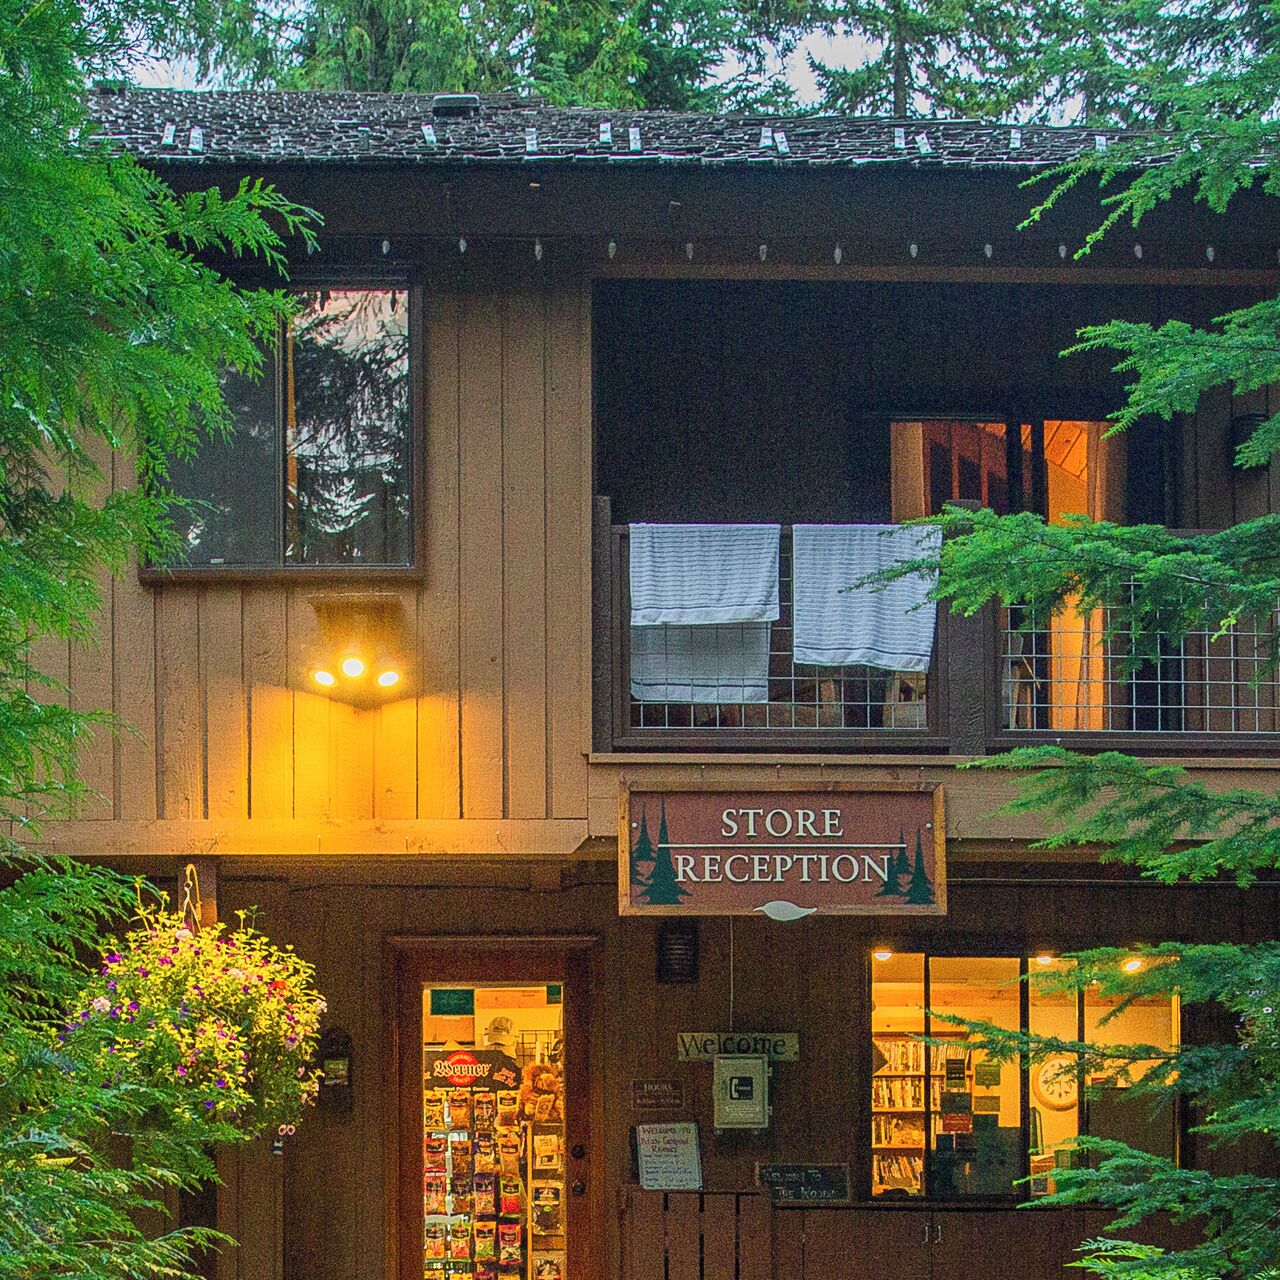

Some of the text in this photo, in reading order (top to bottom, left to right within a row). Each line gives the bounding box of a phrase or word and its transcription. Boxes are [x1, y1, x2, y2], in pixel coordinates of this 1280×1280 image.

[721, 808, 844, 837] STORE
[674, 854, 893, 883] RECEPTION
[679, 1034, 786, 1057] Welcome
[433, 1060, 490, 1077] Werner
